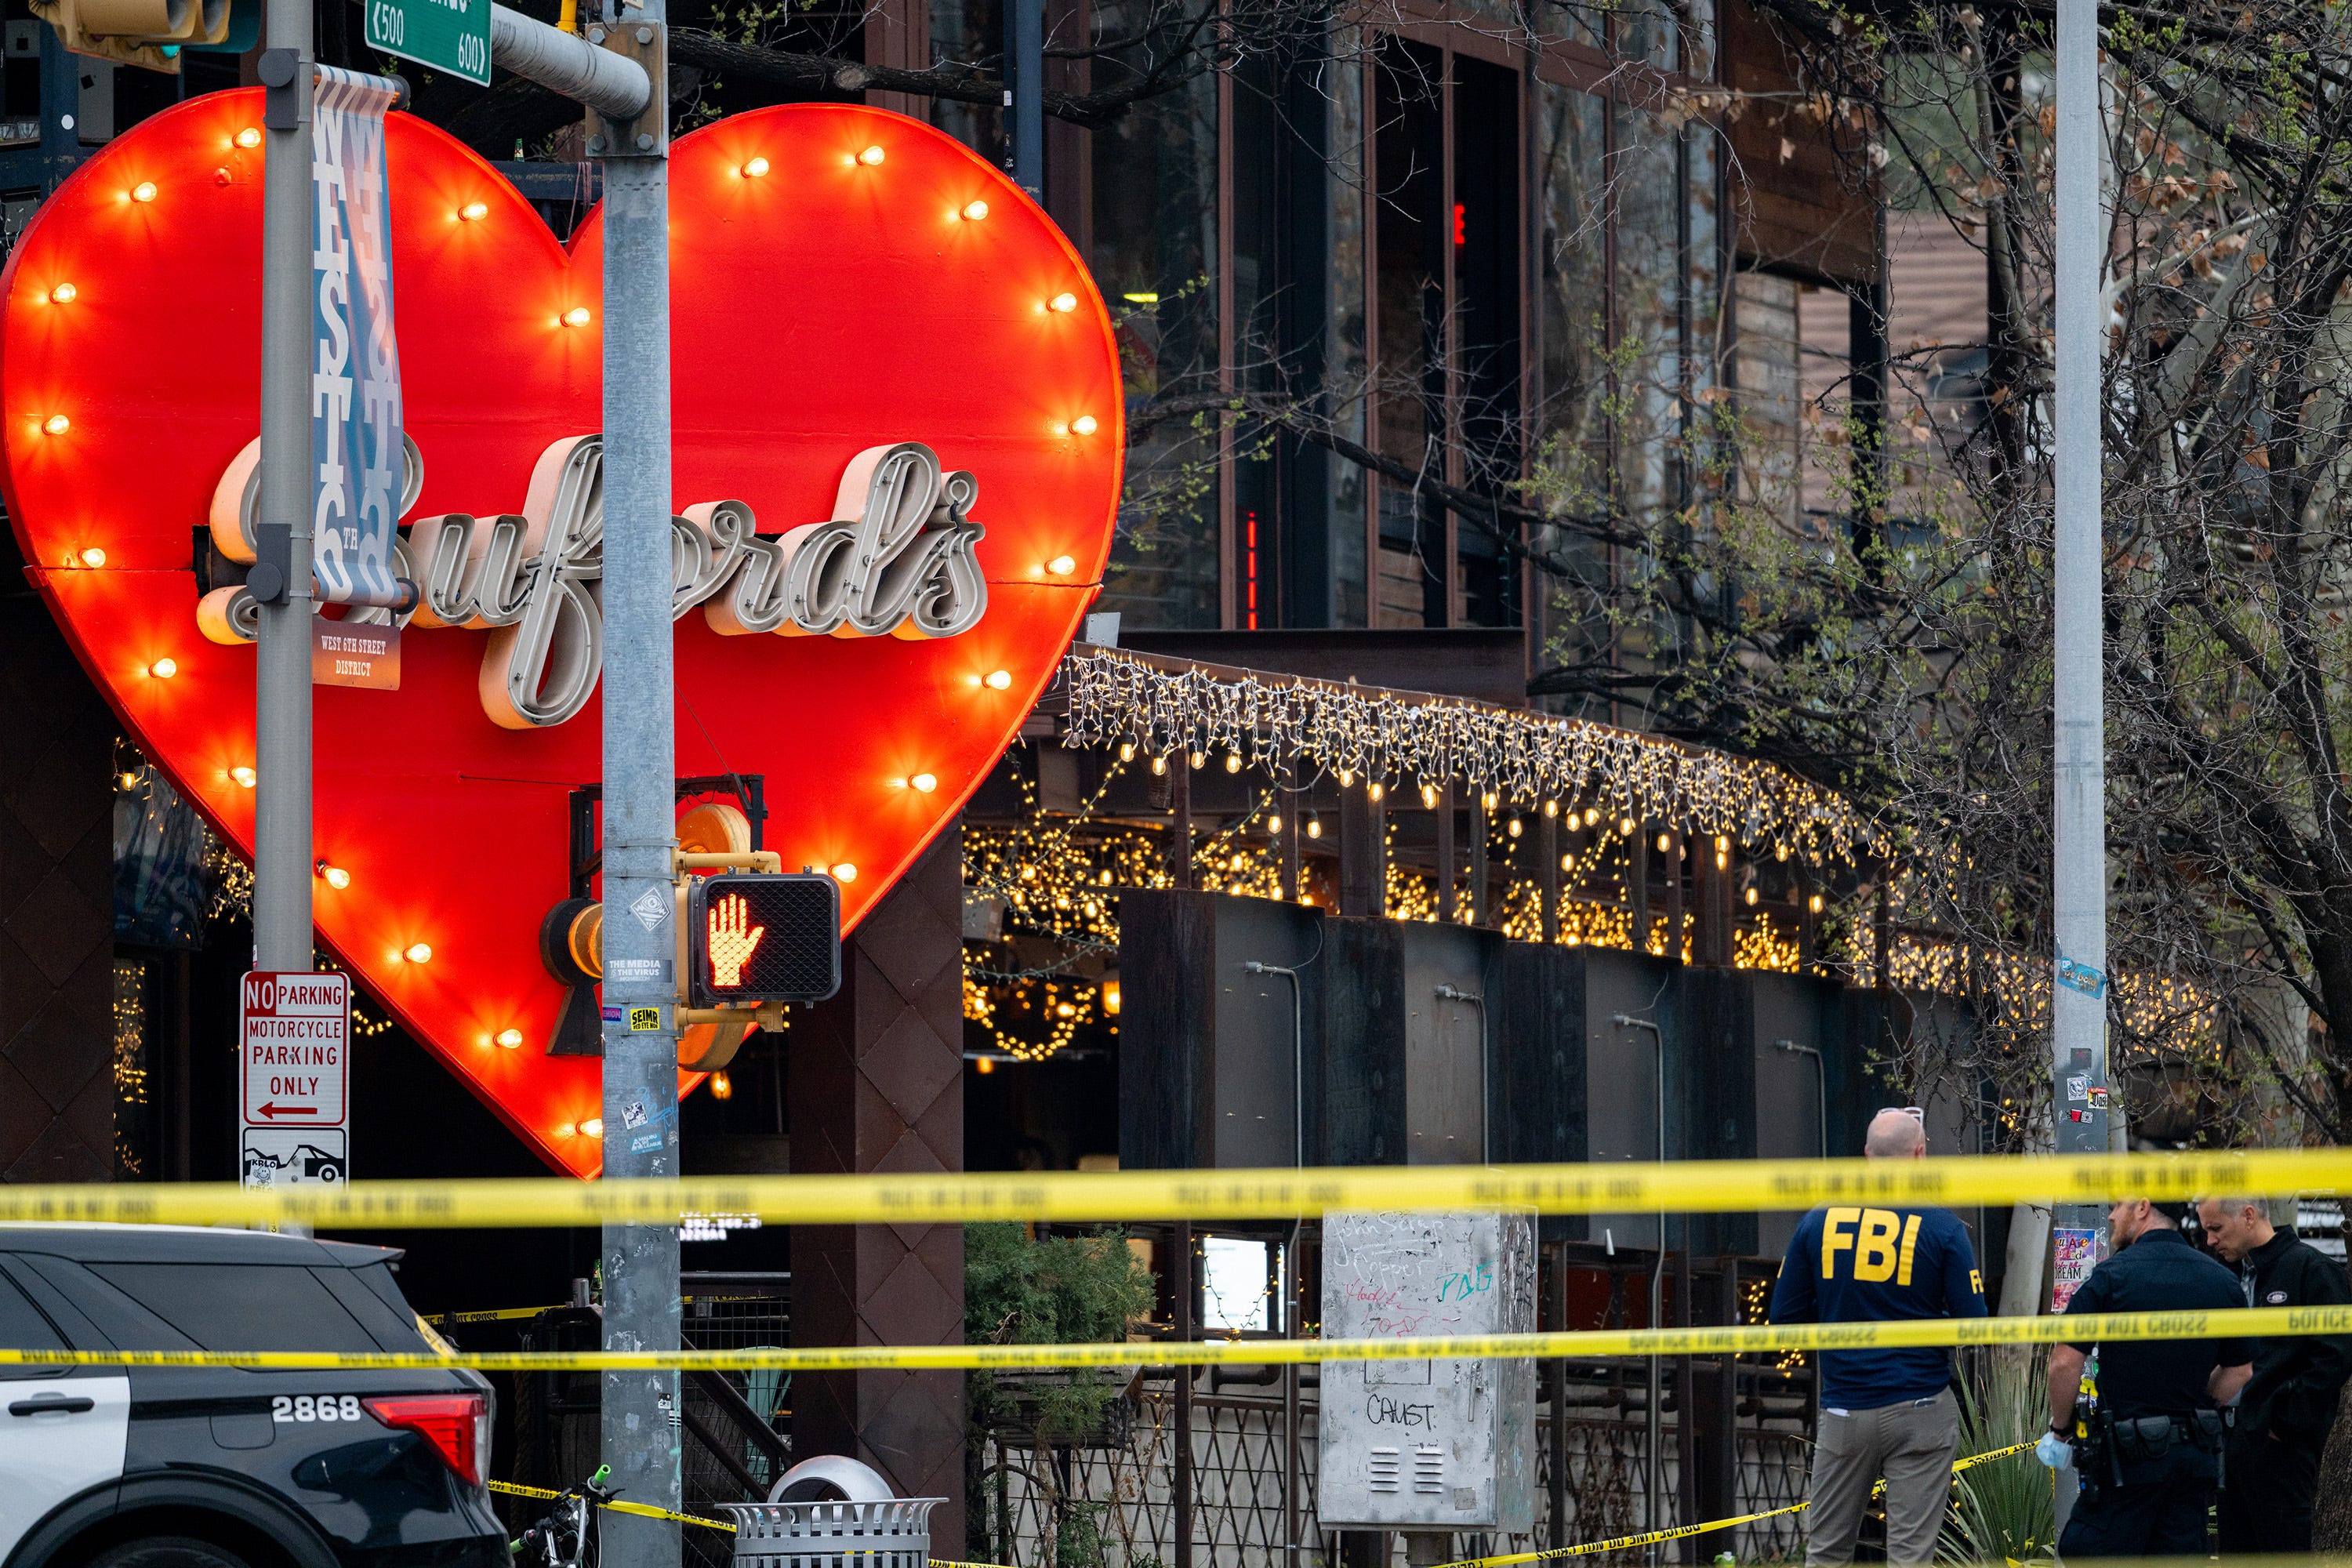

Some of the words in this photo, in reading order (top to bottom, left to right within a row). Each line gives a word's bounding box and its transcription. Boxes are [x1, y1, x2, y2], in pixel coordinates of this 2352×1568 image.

[382, 4, 404, 46] 500
[459, 32, 478, 73] 600
[314, 80, 352, 484] WEST
[196, 431, 988, 730] ufrd's
[321, 635, 342, 651] WEST
[343, 637, 358, 652] 6TH
[358, 638, 387, 655] STREET
[336, 659, 372, 677] DISTRICT
[609, 960, 626, 968] THE
[627, 960, 661, 968] MEDIA
[246, 981, 274, 1010] NO
[278, 986, 343, 1005] PARKING
[249, 1021, 341, 1039] MOTORCYCLE
[253, 1046, 337, 1065] PARKING
[270, 1076, 319, 1096] ONLY
[1821, 1207, 1922, 1287] FBI
[271, 1395, 361, 1422] 2868
